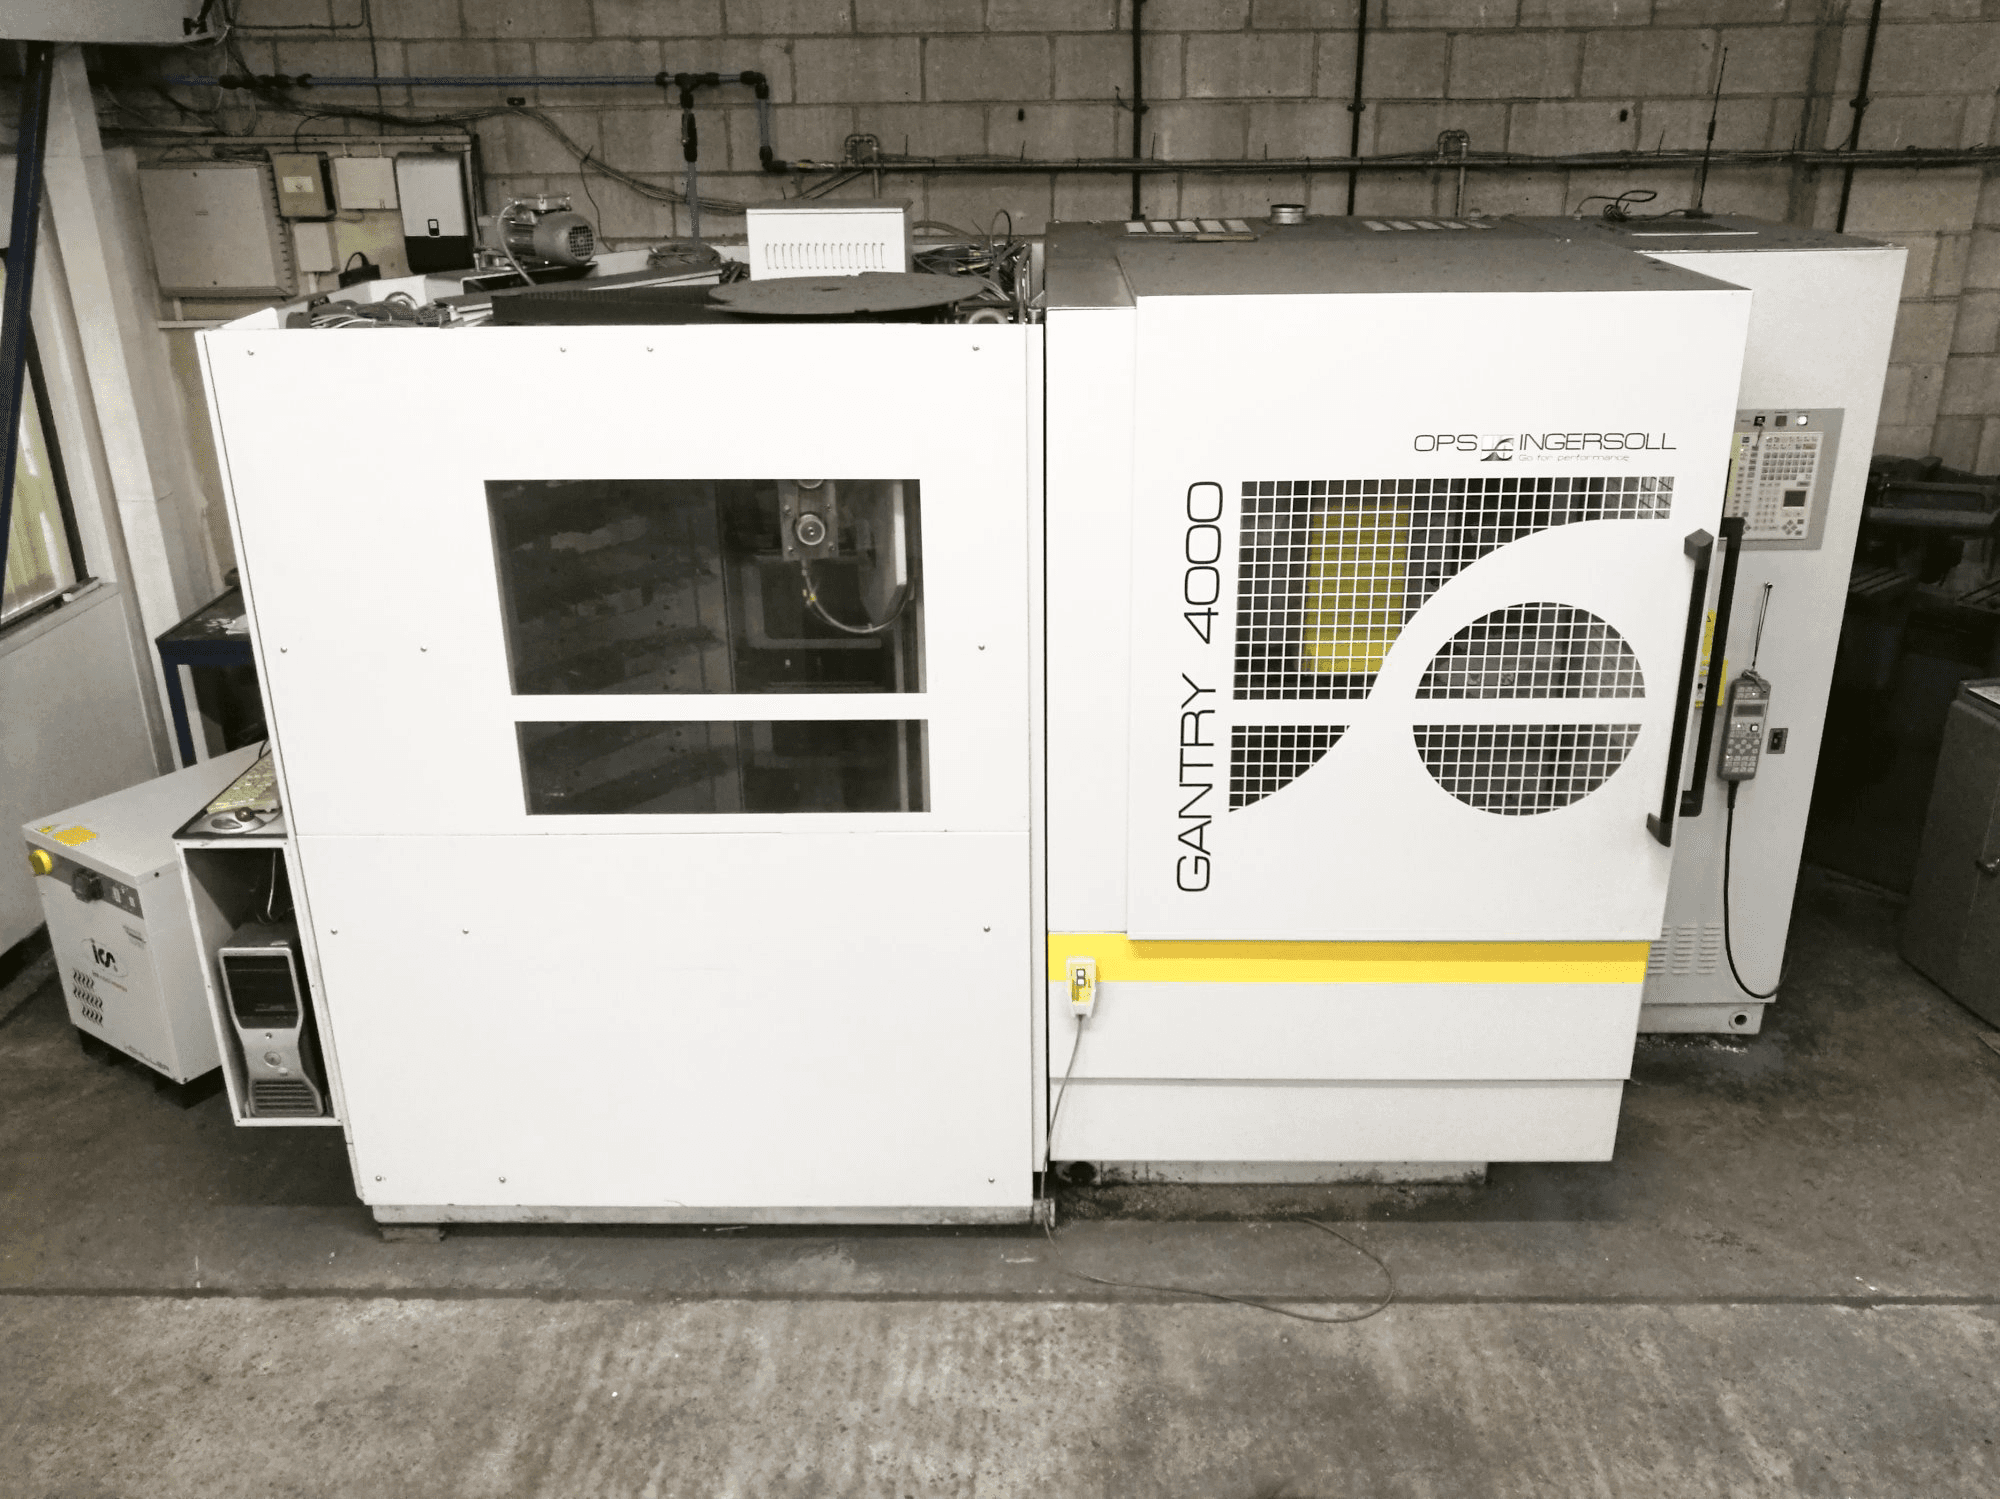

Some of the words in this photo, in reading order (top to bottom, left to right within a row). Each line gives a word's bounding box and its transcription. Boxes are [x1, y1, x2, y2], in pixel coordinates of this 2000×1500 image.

[1414, 433, 1479, 452] OPS
[1519, 433, 1677, 451] INGERSOLL
[1518, 454, 1533, 462] Go
[1537, 453, 1553, 462] for
[1557, 454, 1630, 463] performance
[1183, 481, 1224, 645] 4000
[1176, 672, 1217, 892] GANTRY
